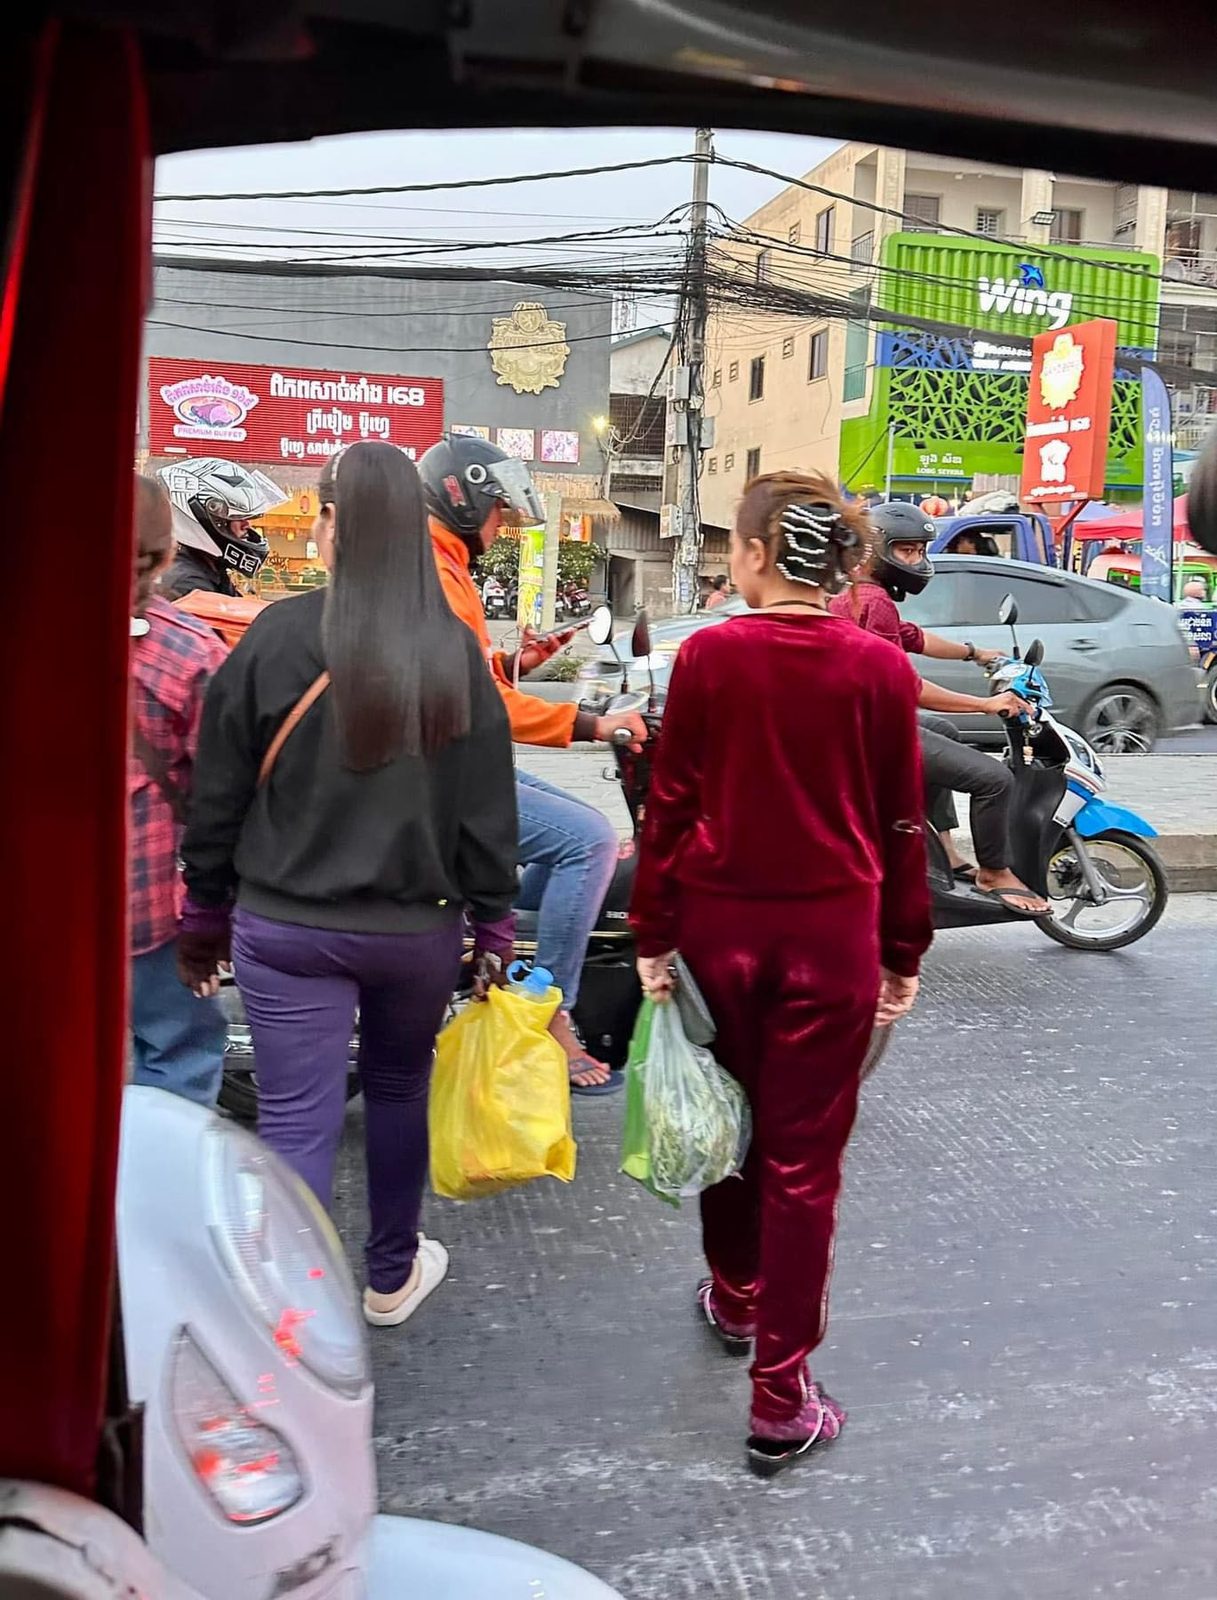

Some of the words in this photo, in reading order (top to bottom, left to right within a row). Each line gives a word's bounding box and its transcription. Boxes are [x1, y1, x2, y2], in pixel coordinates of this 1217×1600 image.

[978, 276, 1073, 330] Wing
[387, 386, 425, 407] 168
[177, 427, 213, 435] PREMIUM
[213, 430, 243, 438] BUFFET
